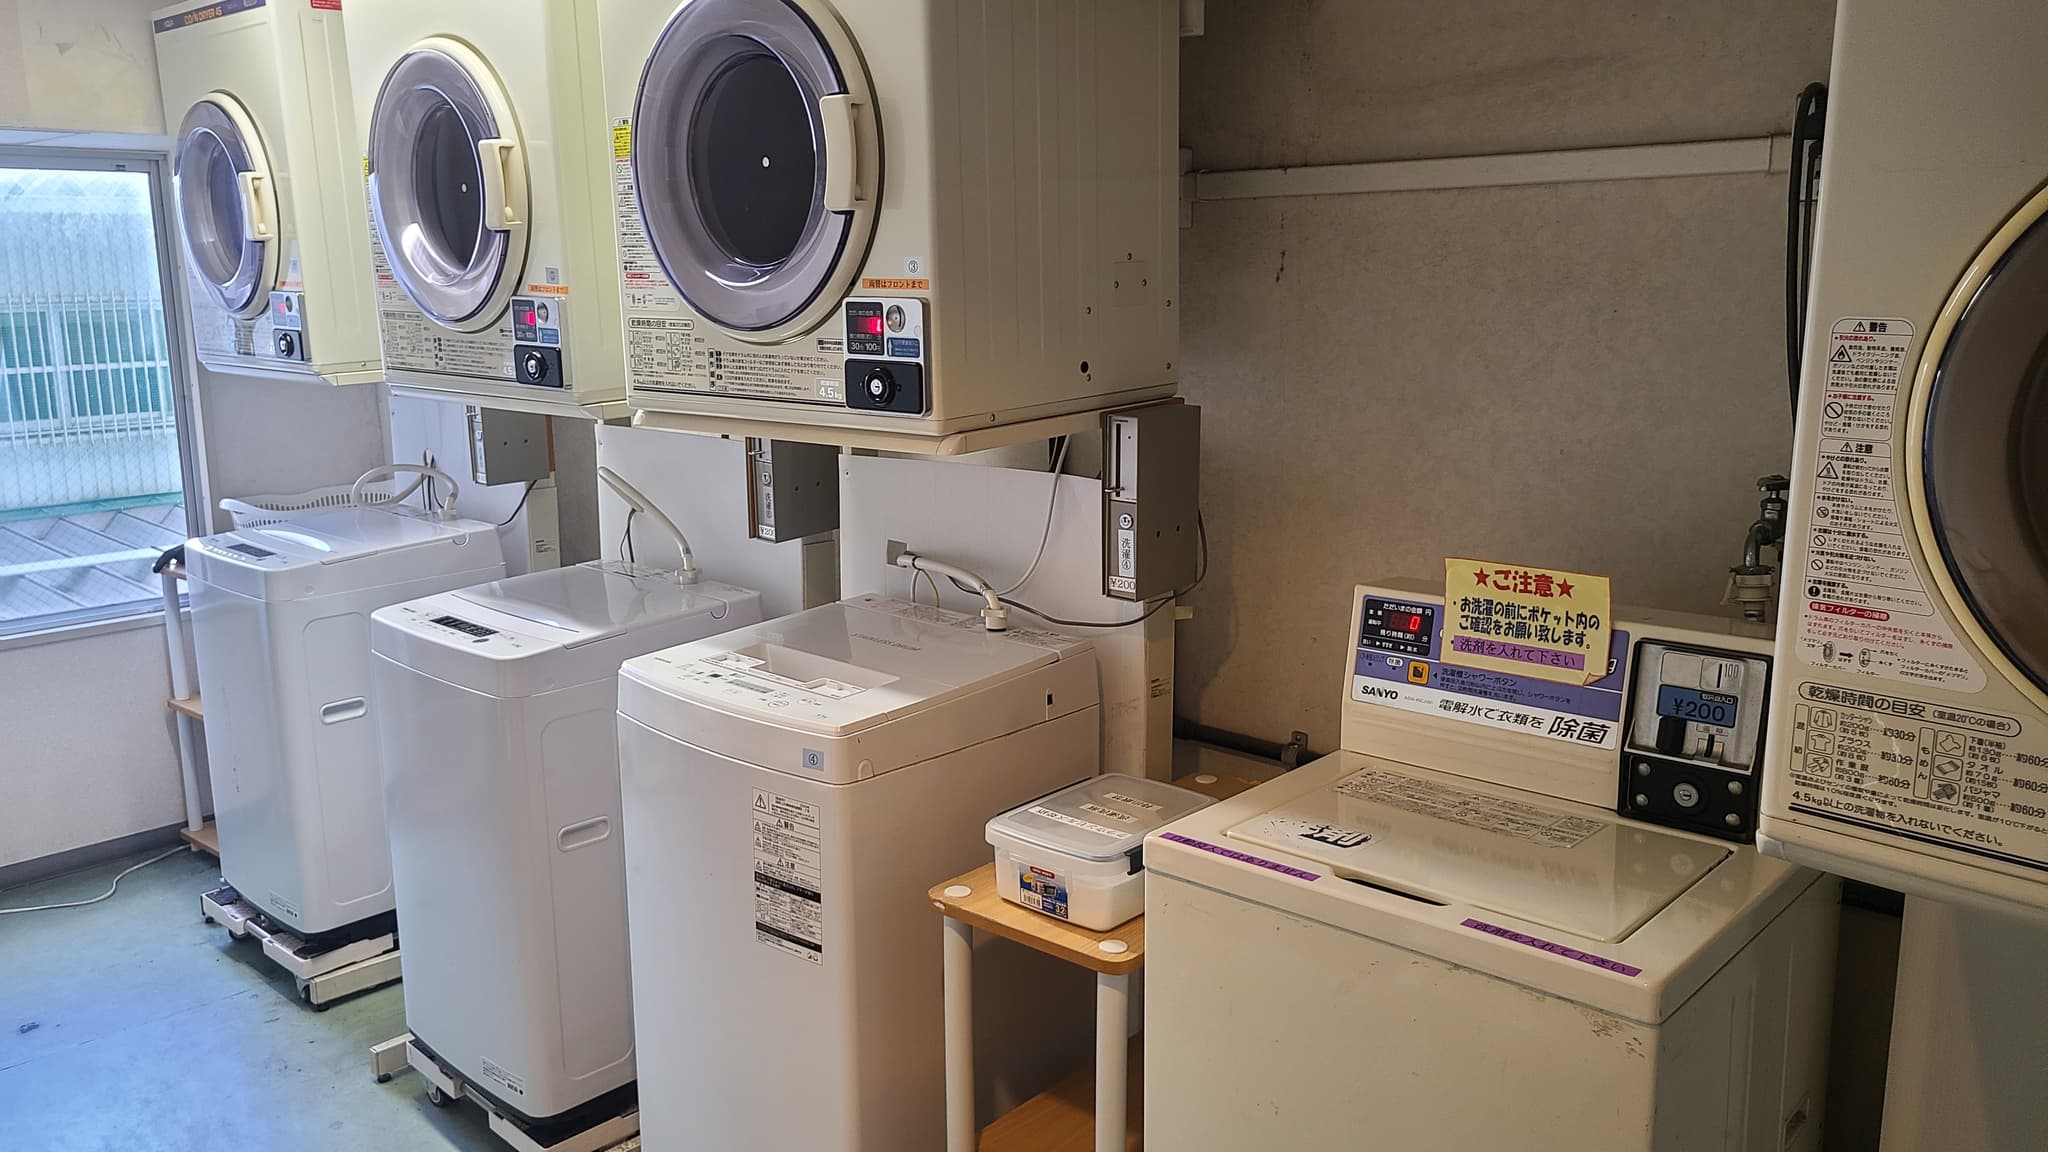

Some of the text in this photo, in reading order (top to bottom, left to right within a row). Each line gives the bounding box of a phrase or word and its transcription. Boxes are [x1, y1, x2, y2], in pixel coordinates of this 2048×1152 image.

[868, 280, 924, 289] 両替はフロントまで
[1855, 443, 1873, 454] 注意
[1110, 577, 1136, 591] ¥200
[1493, 569, 1555, 598] ご注意
[1424, 608, 1432, 616] 円
[1460, 596, 1600, 631] お洗濯の前にポケット内の
[1409, 615, 1421, 631] 0
[1459, 614, 1591, 650] ご確認をお願い致します。
[1459, 637, 1577, 668] 洗剤を入れて下さい
[1361, 685, 1398, 700] SANYO
[1672, 698, 1726, 722] ¥200
[1808, 685, 1926, 719] 乾燥時間の目安
[1439, 698, 1612, 745] 電解水で衣類を 除菌
[1838, 735, 1871, 748] ブラウス
[1883, 727, 1916, 742] 約30分
[1880, 751, 1914, 766] 約30分
[1918, 746, 1930, 780] もめん
[1966, 761, 2004, 775] タオル
[1963, 785, 2001, 799] パジャマ
[2013, 777, 2048, 794] 約60分
[1792, 790, 2003, 847] 4.5kg以上の洗濯物を入れないでください。
[2010, 803, 2047, 819] 約60分
